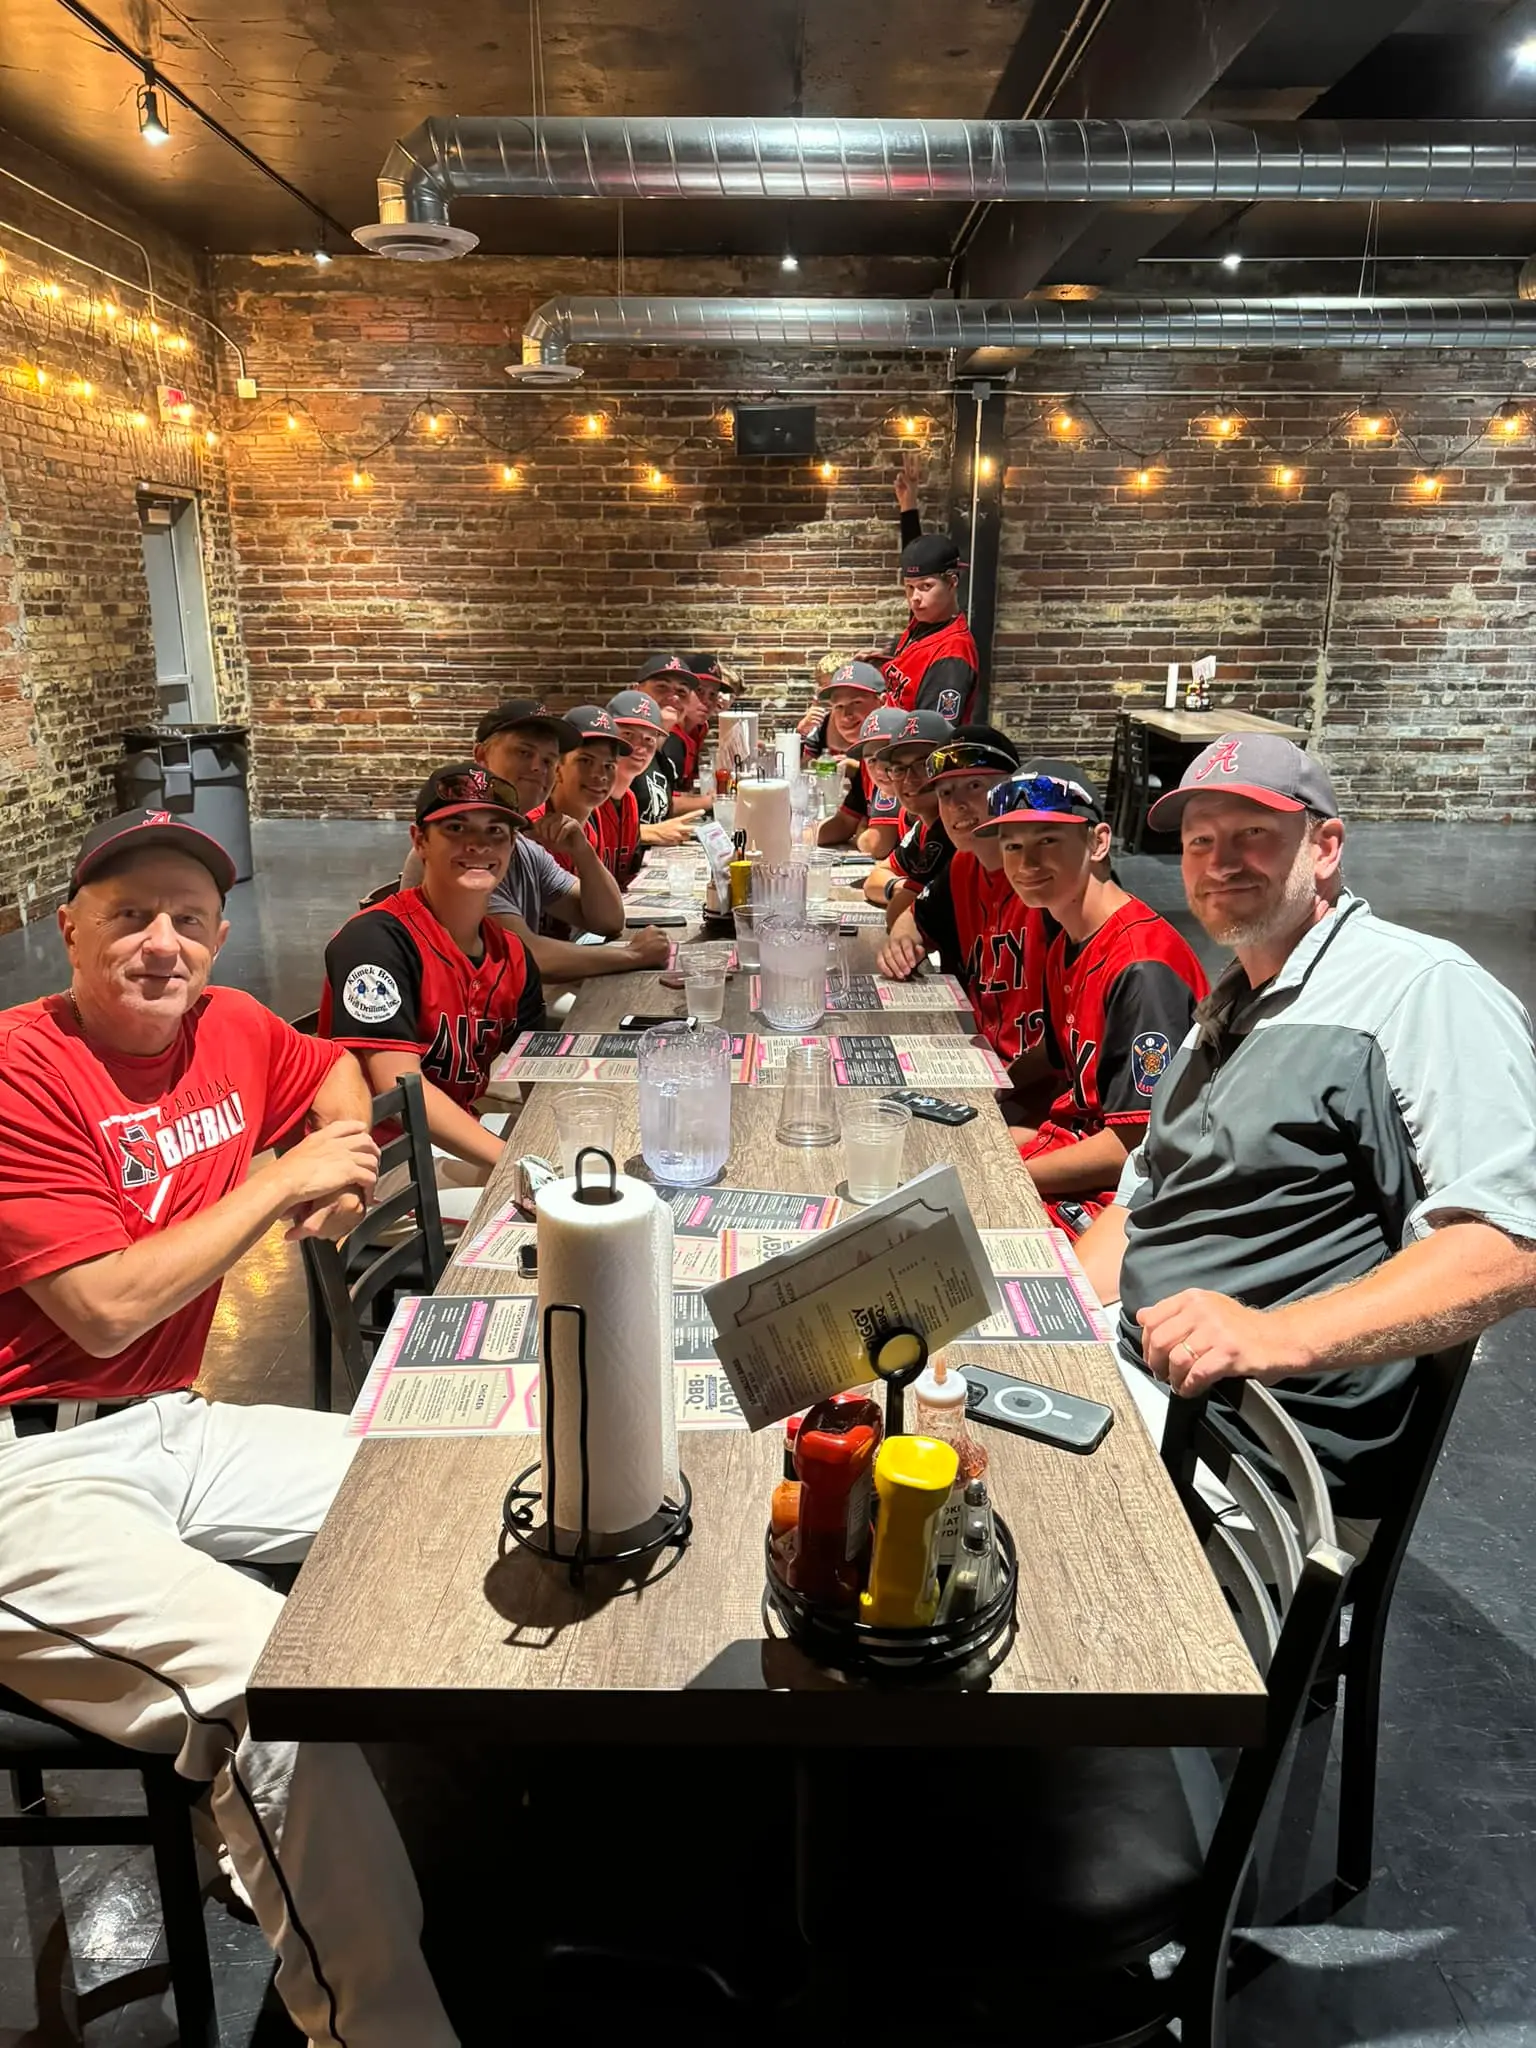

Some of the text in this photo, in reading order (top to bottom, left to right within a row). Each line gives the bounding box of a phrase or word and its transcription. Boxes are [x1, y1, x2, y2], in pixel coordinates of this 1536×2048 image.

[1194, 739, 1242, 781] A
[347, 967, 375, 985] Klimek
[360, 1003, 388, 1013] Drilling
[475, 1383, 489, 1411] CHICKEN
[685, 1379, 705, 1405] BBQ
[719, 1367, 743, 1416] IGGY
